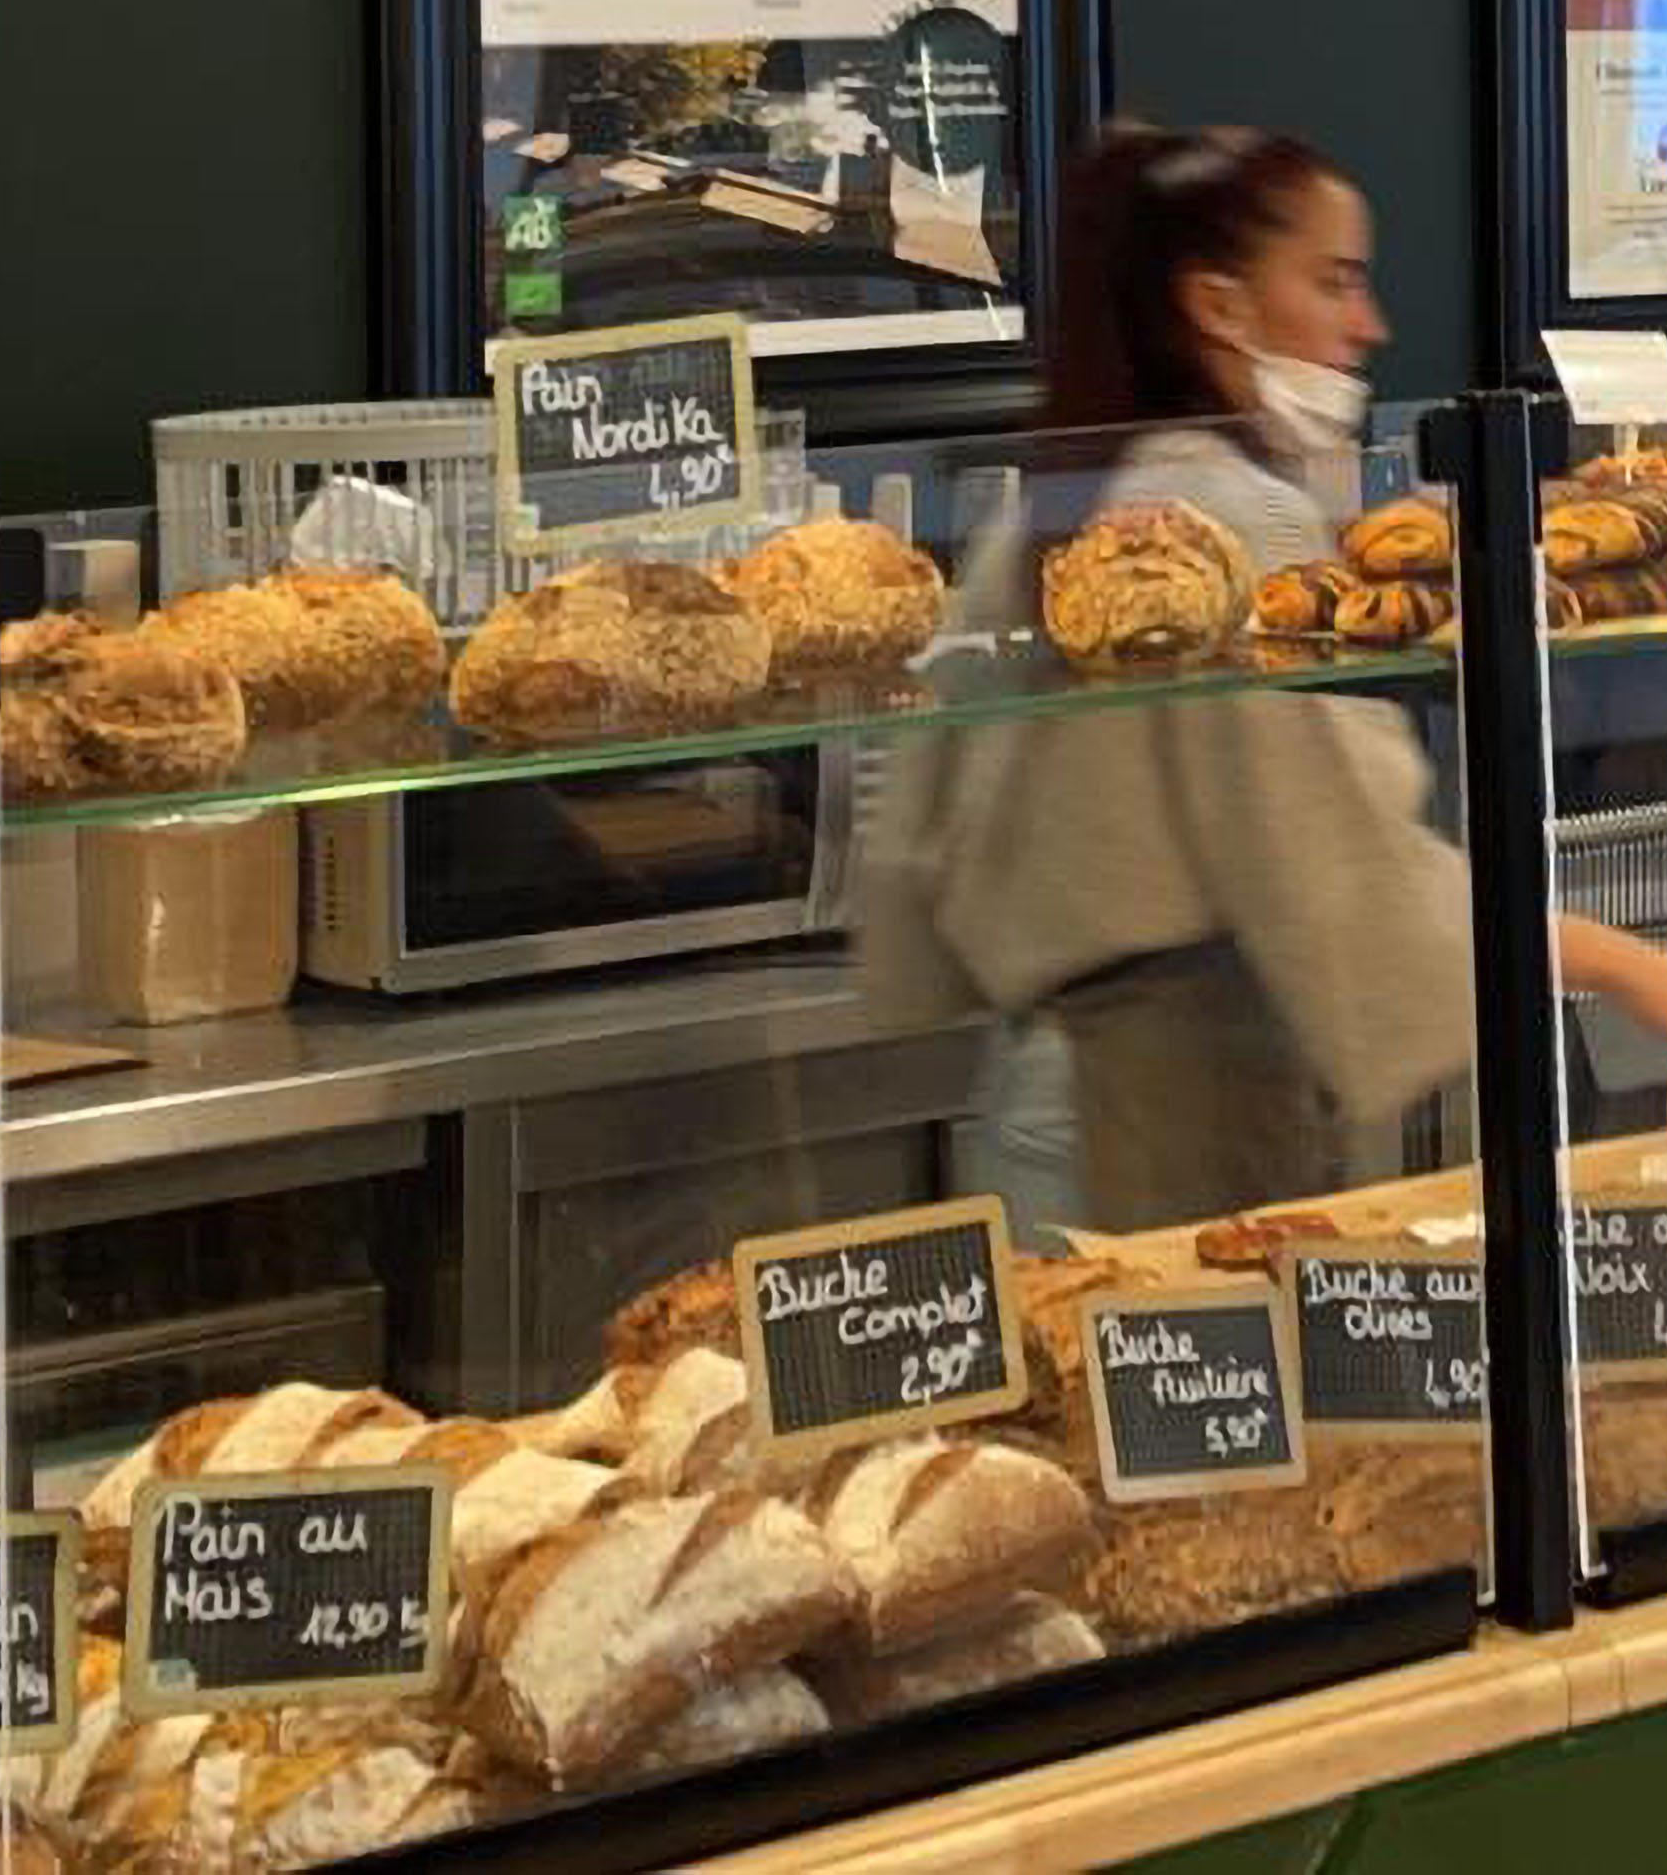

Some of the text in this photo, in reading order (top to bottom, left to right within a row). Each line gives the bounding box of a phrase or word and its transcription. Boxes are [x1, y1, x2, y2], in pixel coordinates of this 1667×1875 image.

[521, 362, 603, 415] Pain
[1558, 1201, 1634, 1248] che
[758, 1249, 888, 1322] Buche
[838, 1275, 987, 1345] complet
[150, 1492, 369, 1566] Pain au
